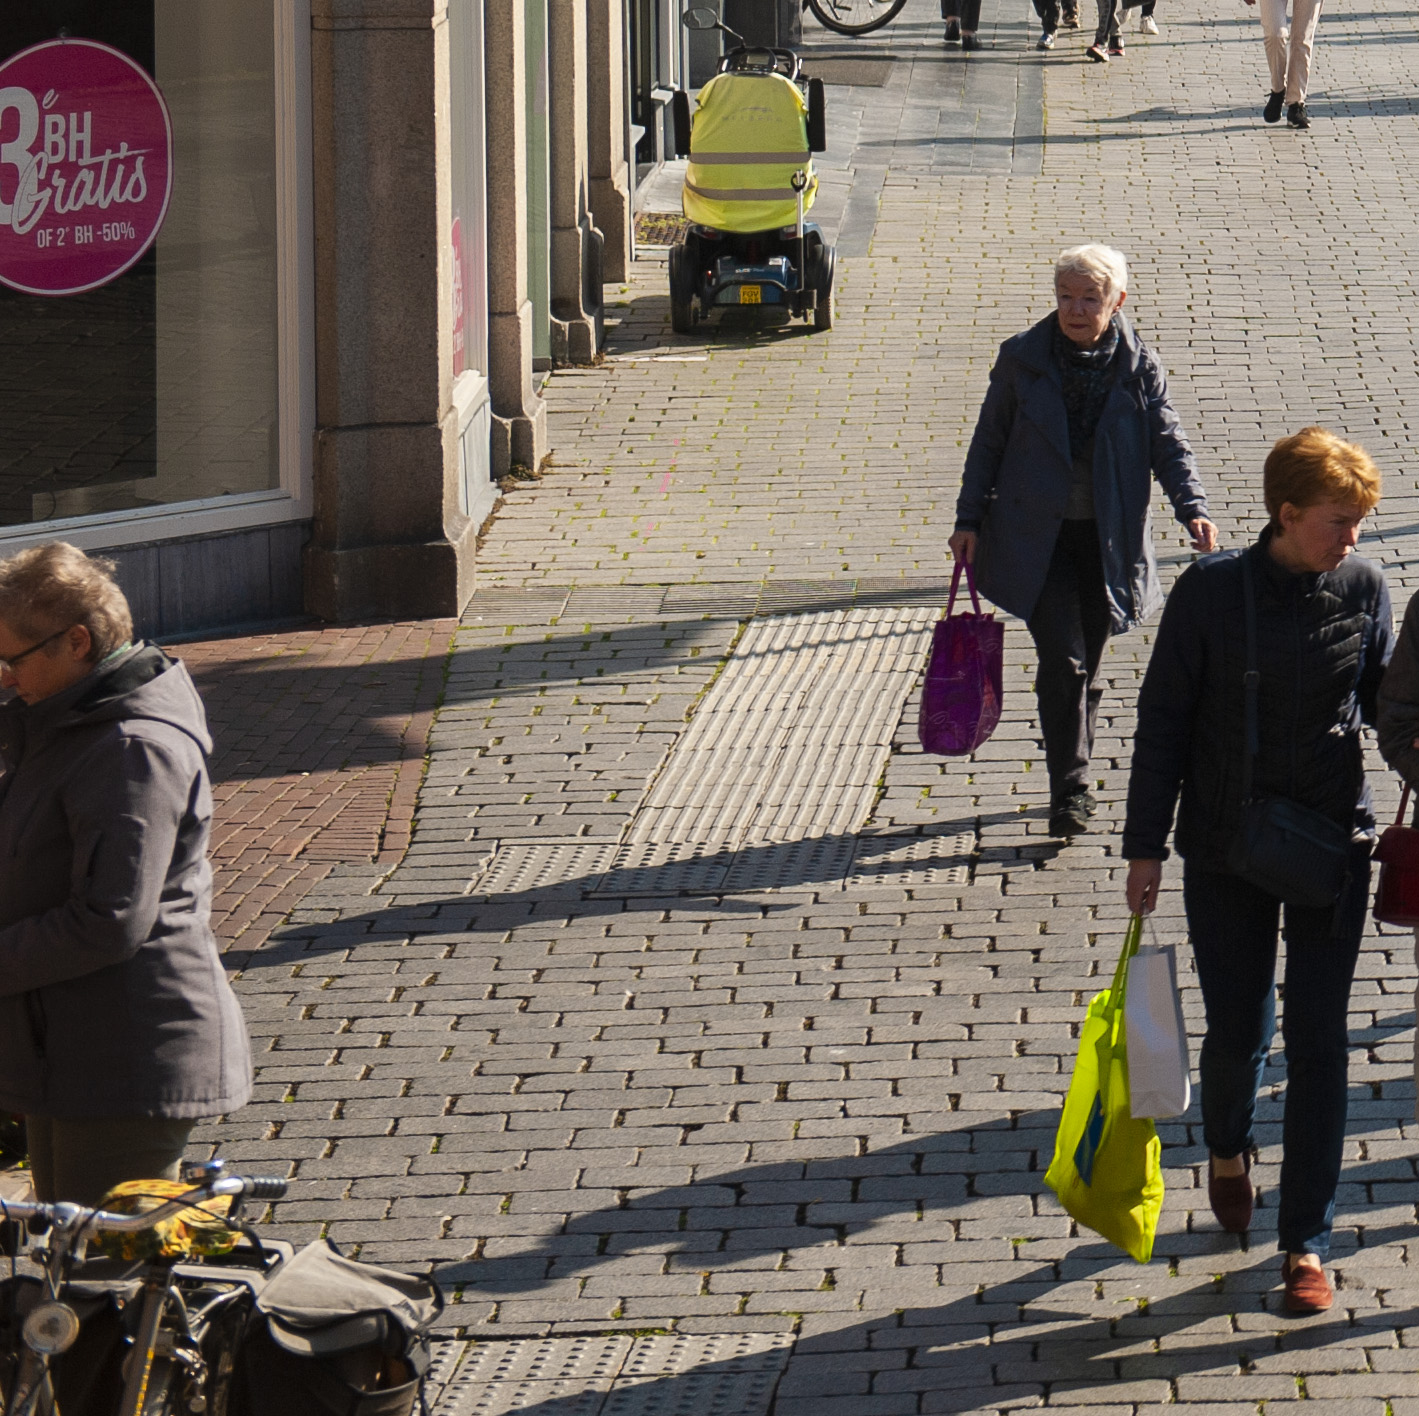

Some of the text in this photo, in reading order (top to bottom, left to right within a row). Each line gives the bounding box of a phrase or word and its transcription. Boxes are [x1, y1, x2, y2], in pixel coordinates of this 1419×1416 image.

[44, 111, 92, 164] BH
[11, 142, 153, 235] Gratis
[37, 229, 53, 248] OF
[75, 225, 93, 244] BH
[97, 221, 135, 242] -50%
